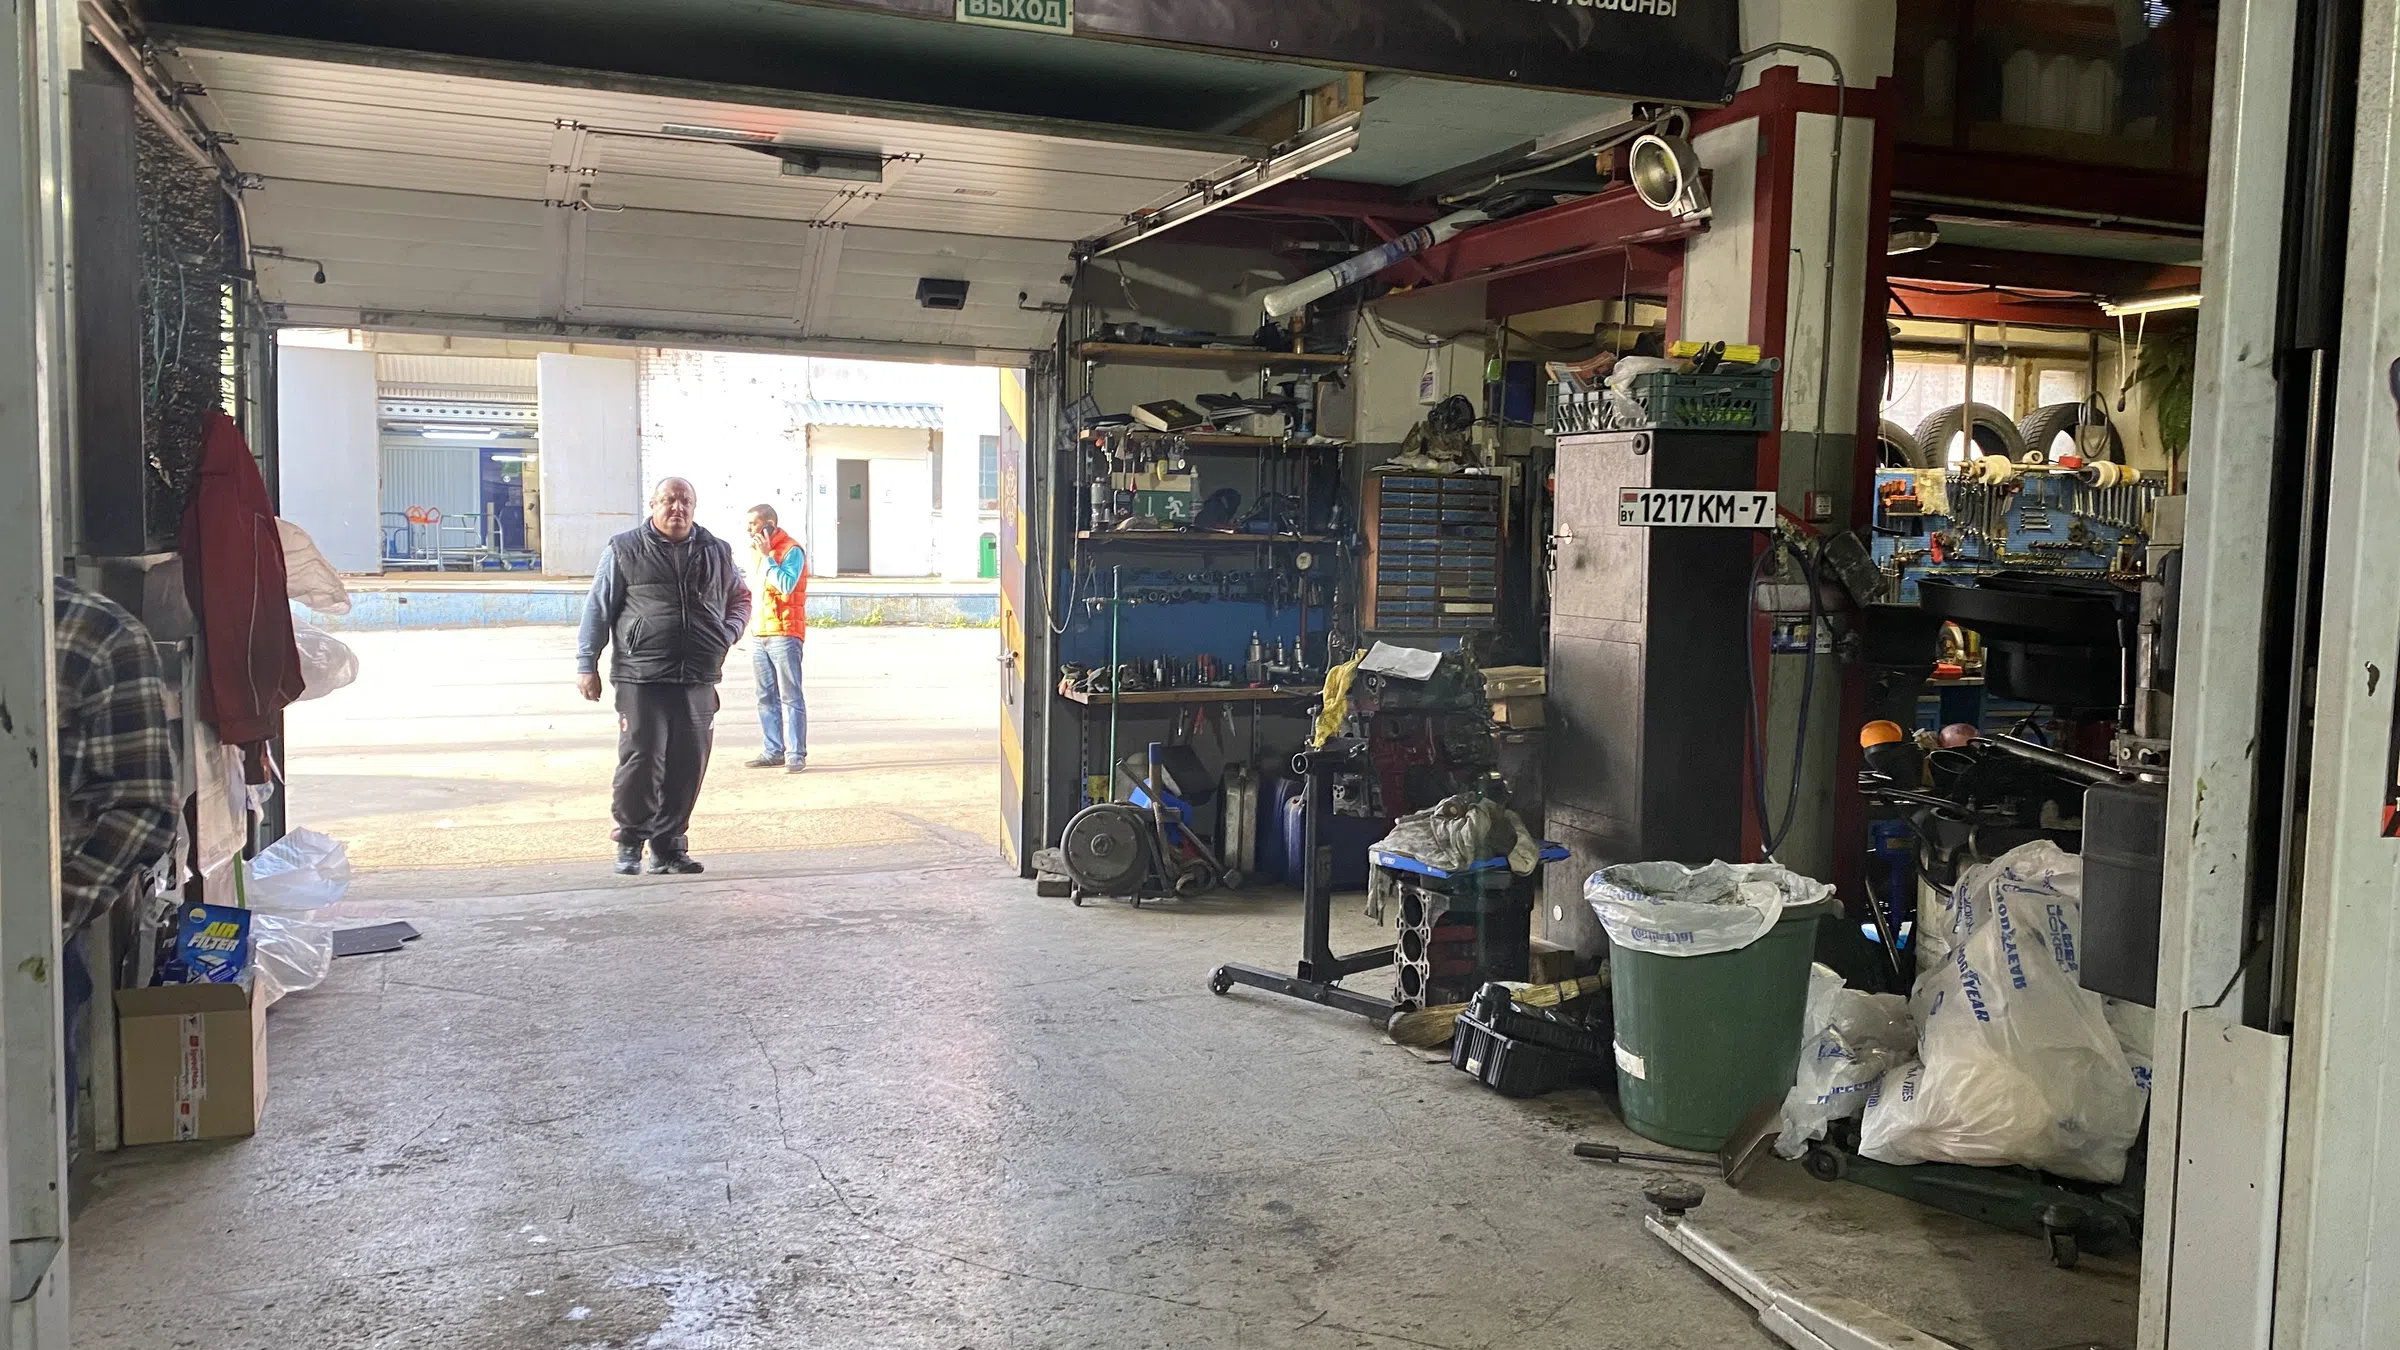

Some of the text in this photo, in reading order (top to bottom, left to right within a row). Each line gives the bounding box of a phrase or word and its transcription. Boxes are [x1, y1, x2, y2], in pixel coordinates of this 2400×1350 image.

[969, 0, 1062, 26] ВЫХОД
[1620, 510, 1635, 522] BY
[204, 921, 240, 939] AIR
[187, 932, 240, 952] FILTER
